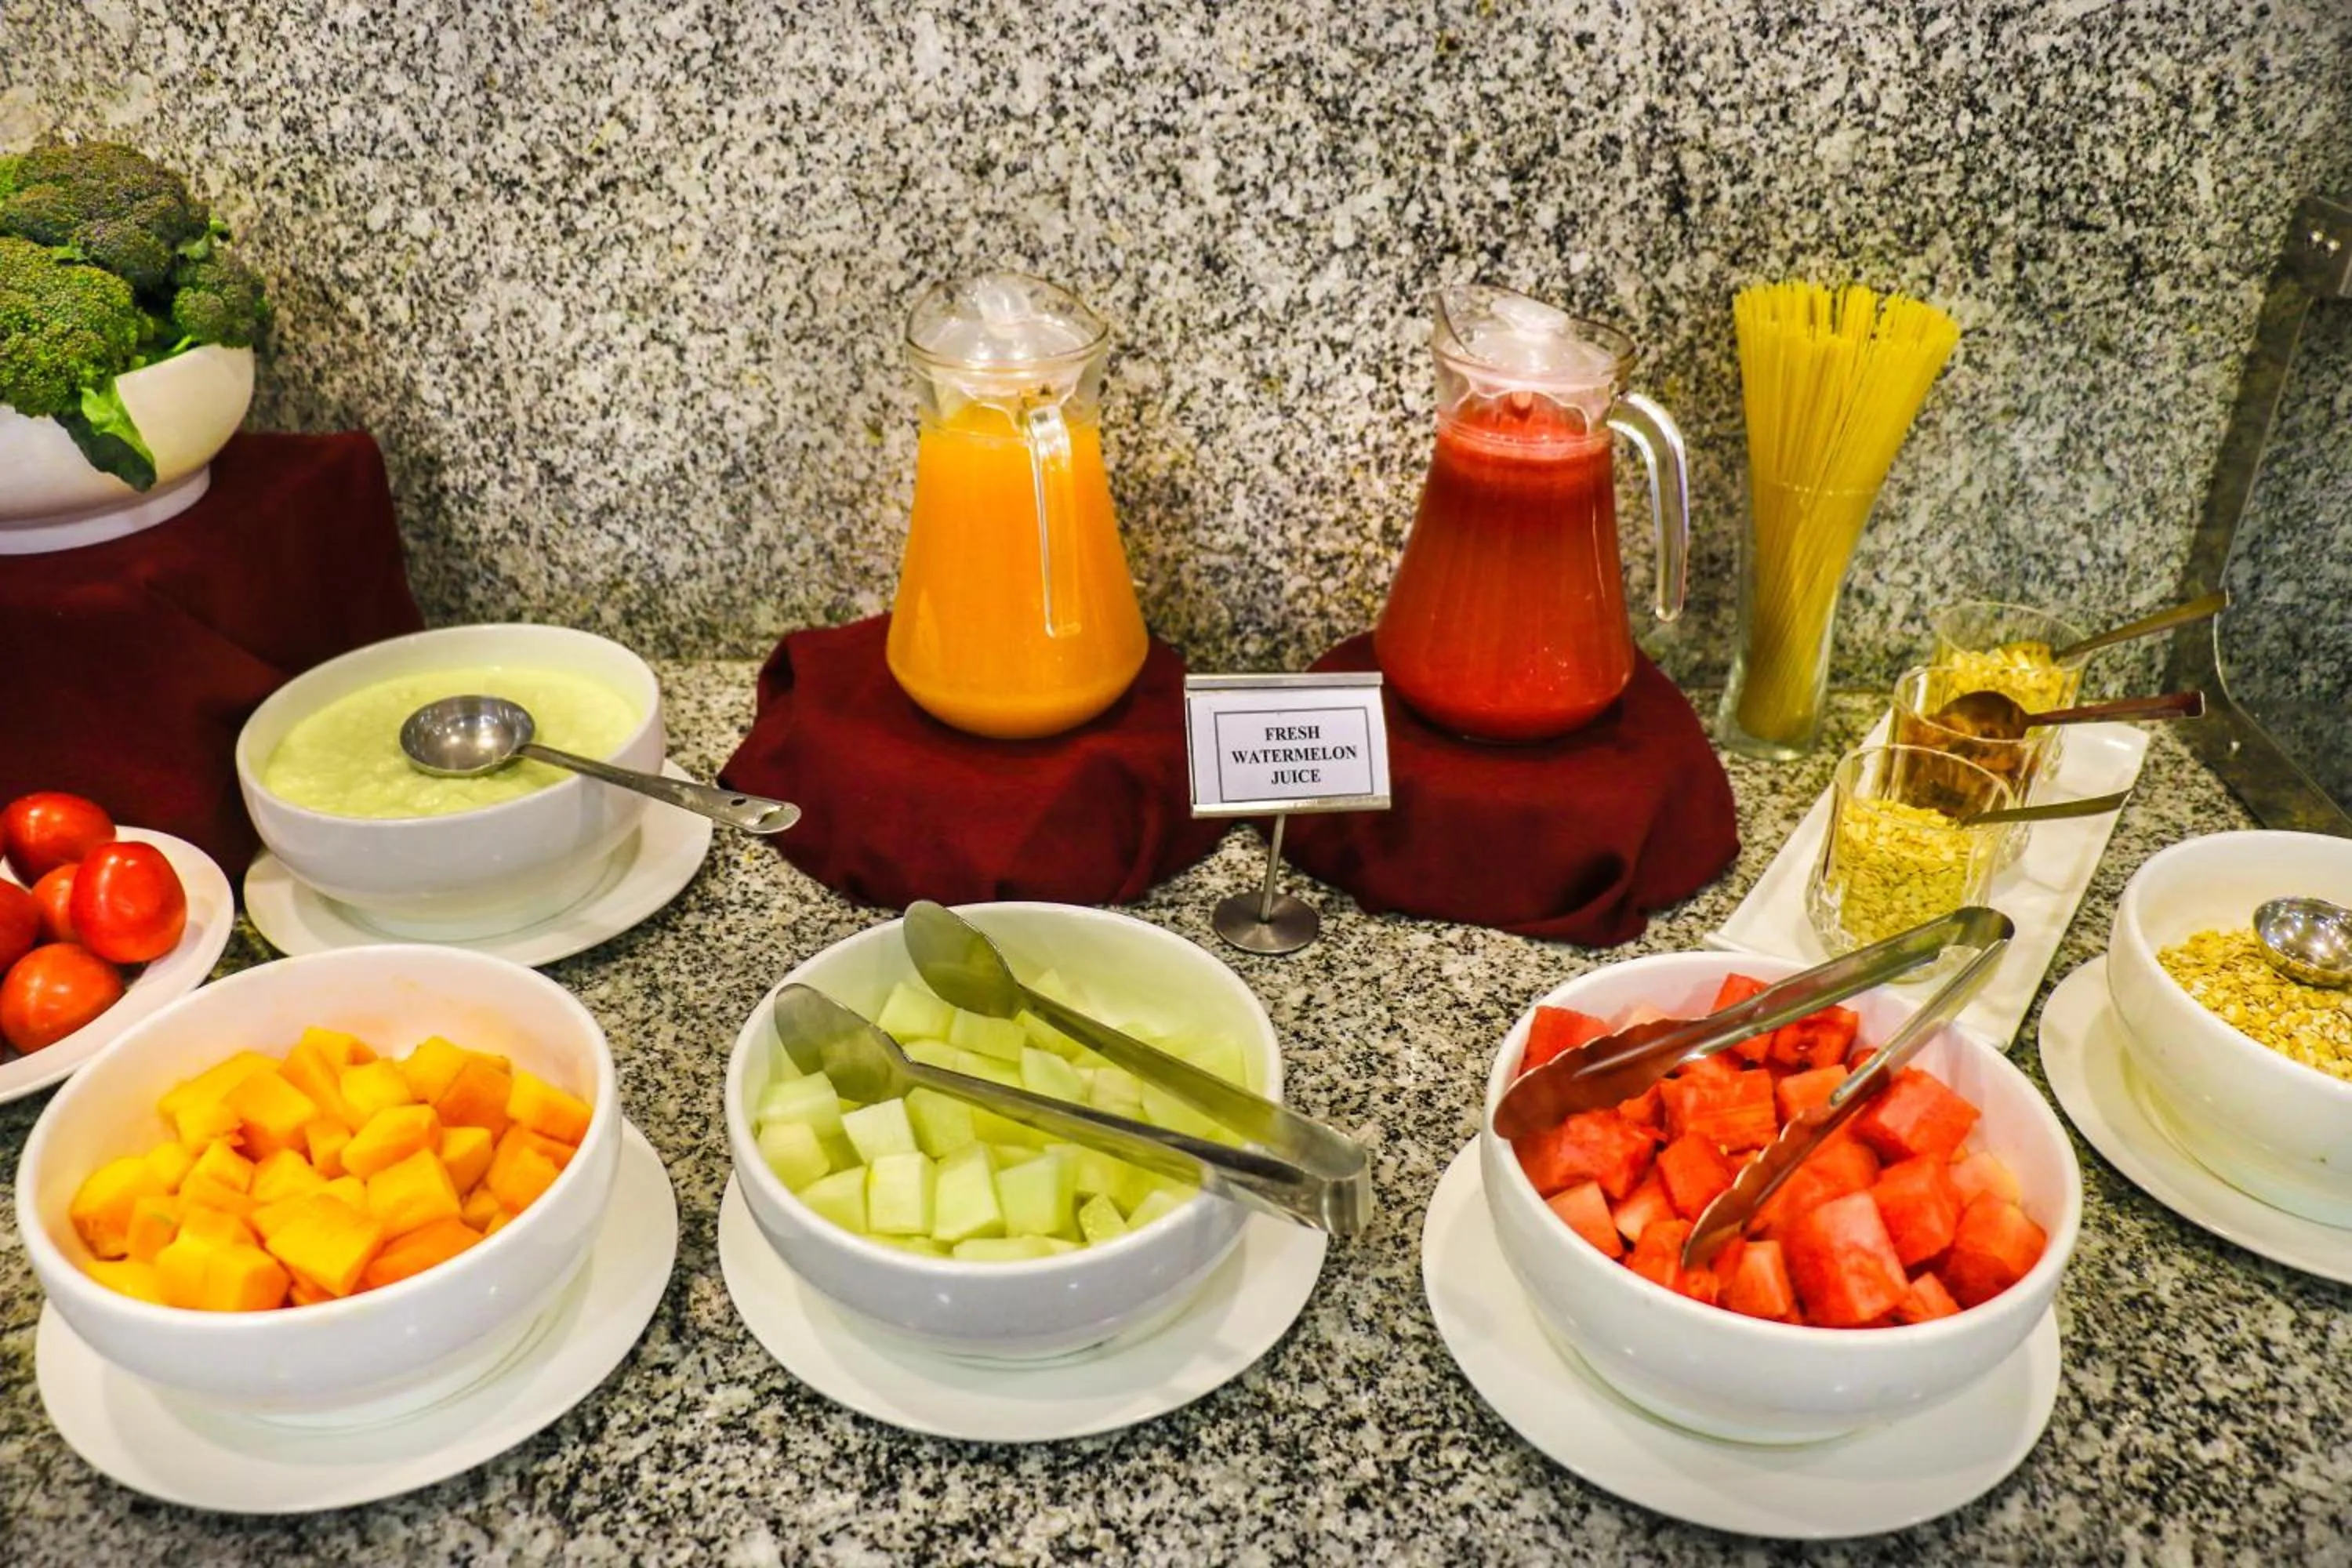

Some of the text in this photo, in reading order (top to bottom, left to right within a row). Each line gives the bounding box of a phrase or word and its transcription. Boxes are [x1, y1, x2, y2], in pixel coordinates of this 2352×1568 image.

[1265, 725, 1320, 741] FRESH
[1231, 746, 1358, 764] WATERMELON
[1271, 769, 1321, 785] JUICE
